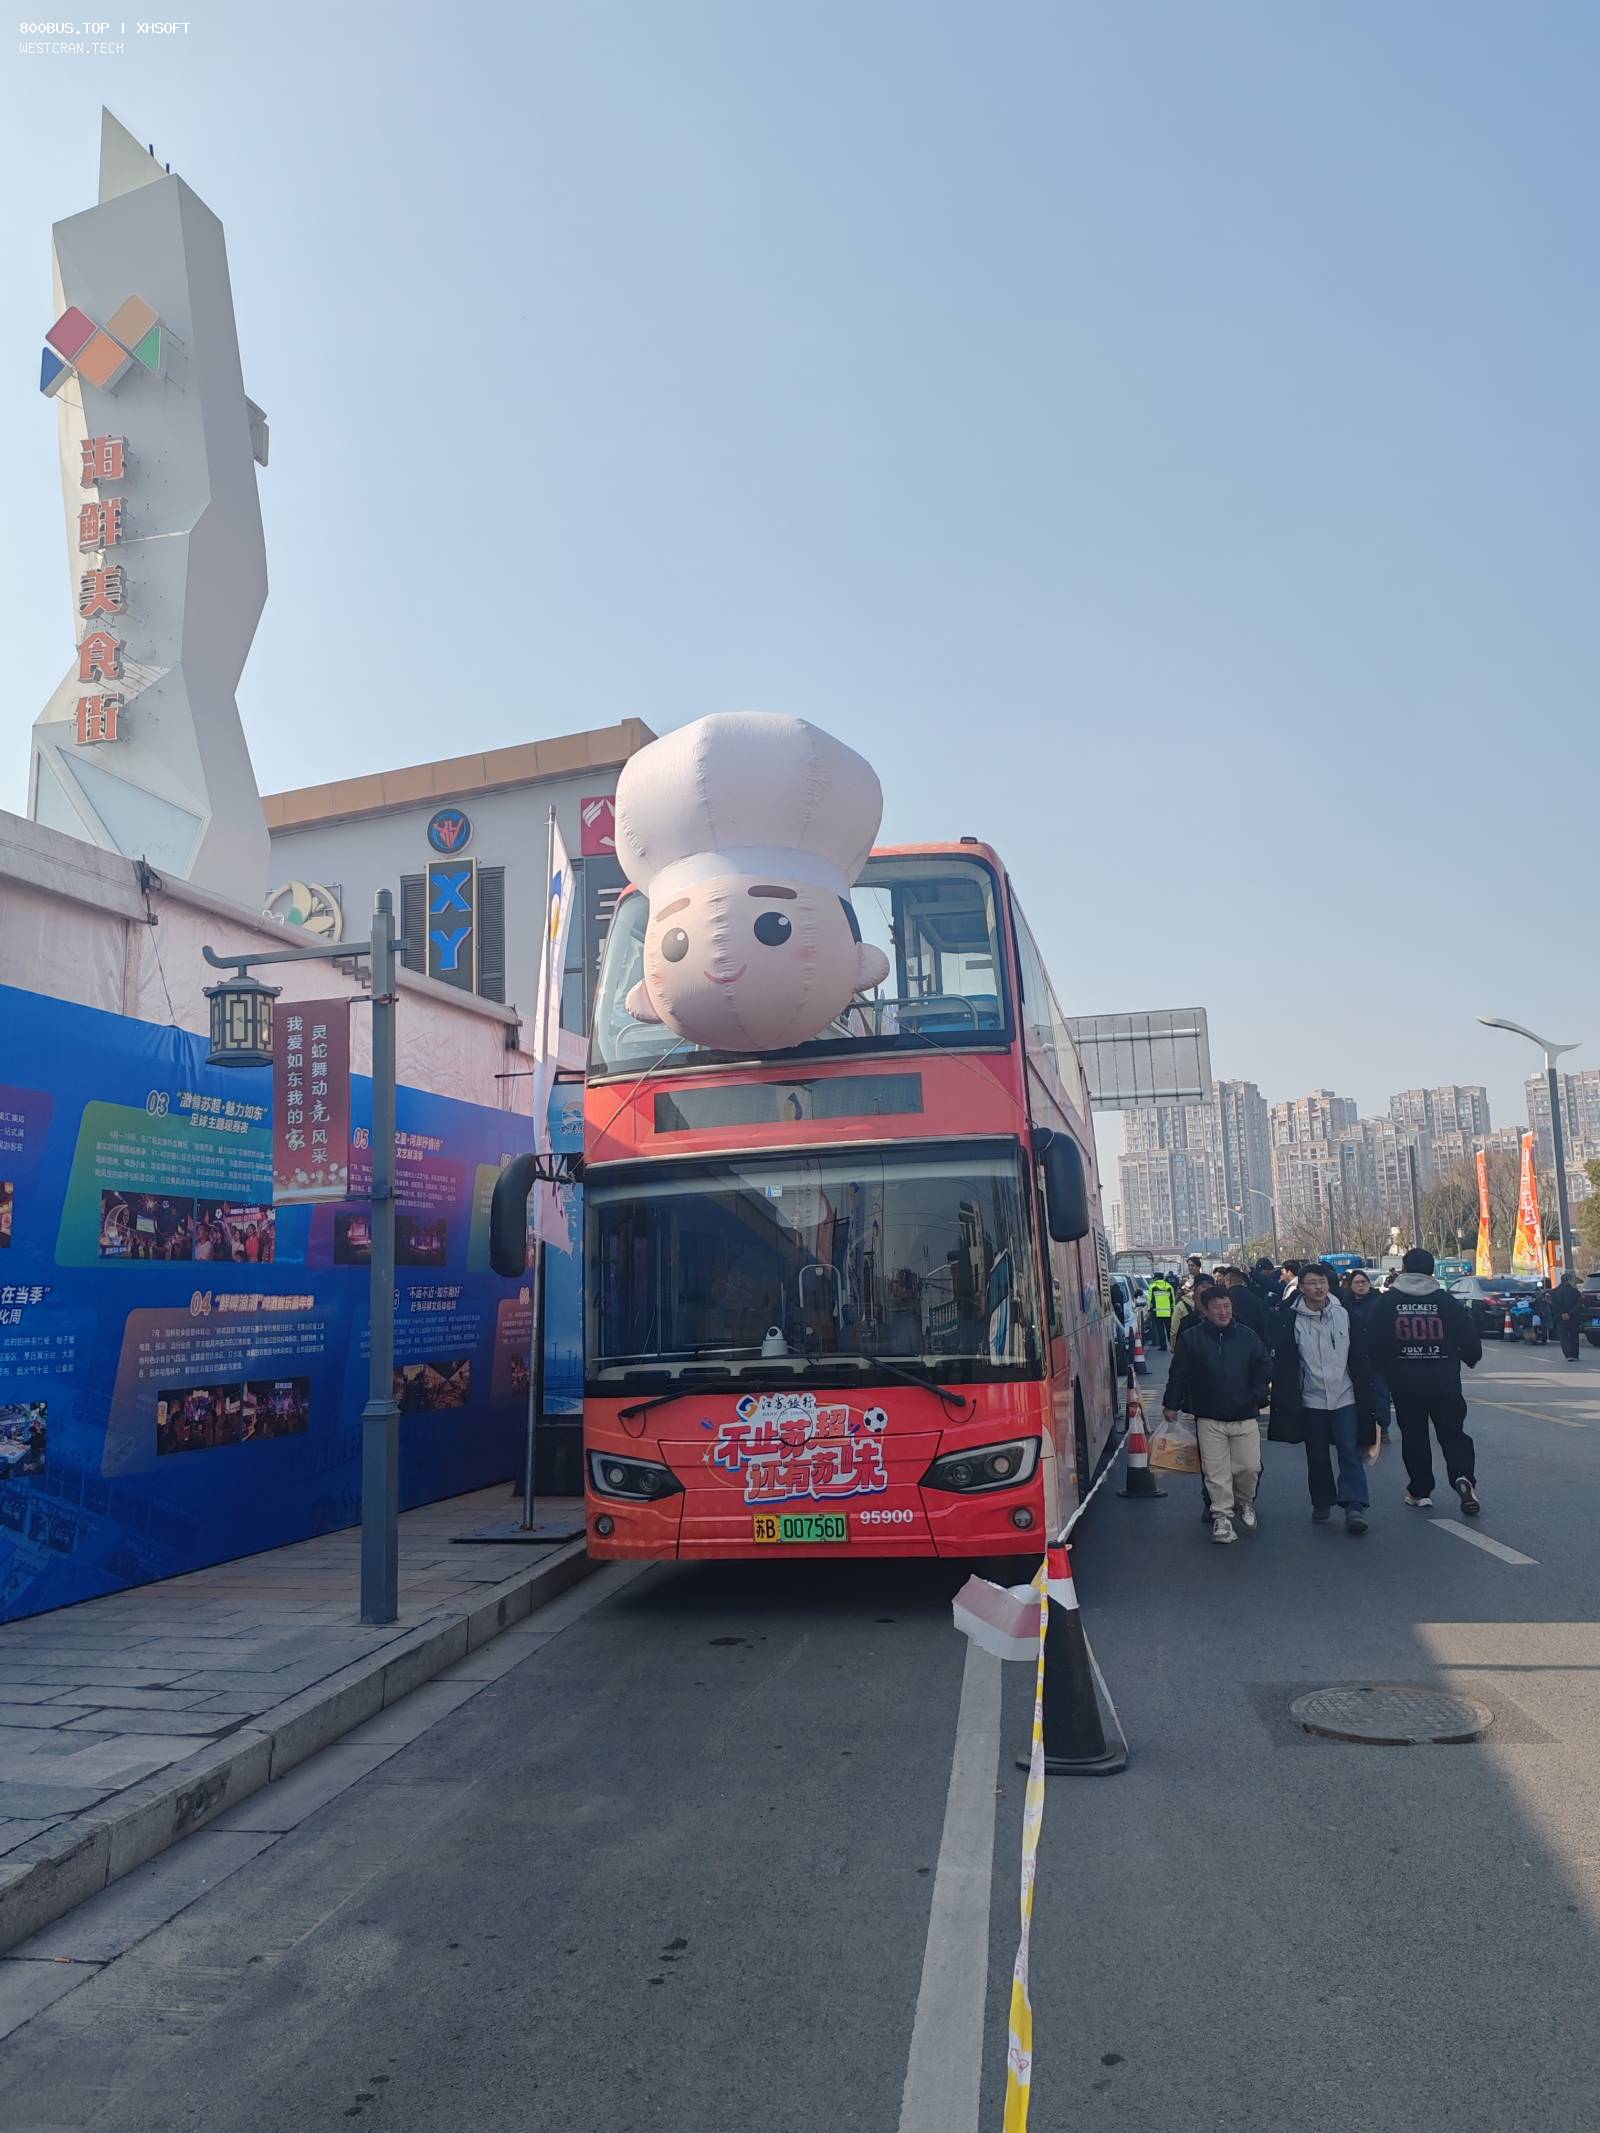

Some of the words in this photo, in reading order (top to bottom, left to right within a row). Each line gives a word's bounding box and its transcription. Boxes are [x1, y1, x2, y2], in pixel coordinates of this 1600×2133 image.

[75, 433, 129, 746] 海鲜美食街
[285, 1015, 306, 1152] 我爱如东我的家
[308, 1024, 330, 1165] 灵蛇舞动竞风采
[146, 1089, 170, 1118] 03
[353, 1127, 370, 1150] 05
[190, 1290, 213, 1317] 04
[1396, 1303, 1439, 1312] CRICKETS
[1428, 1345, 1440, 1353] 12
[760, 1394, 814, 1410] 江苏银行
[717, 1407, 852, 1468] 不止苏超
[747, 1440, 886, 1500] 还有苏味
[860, 1509, 914, 1525] 95900
